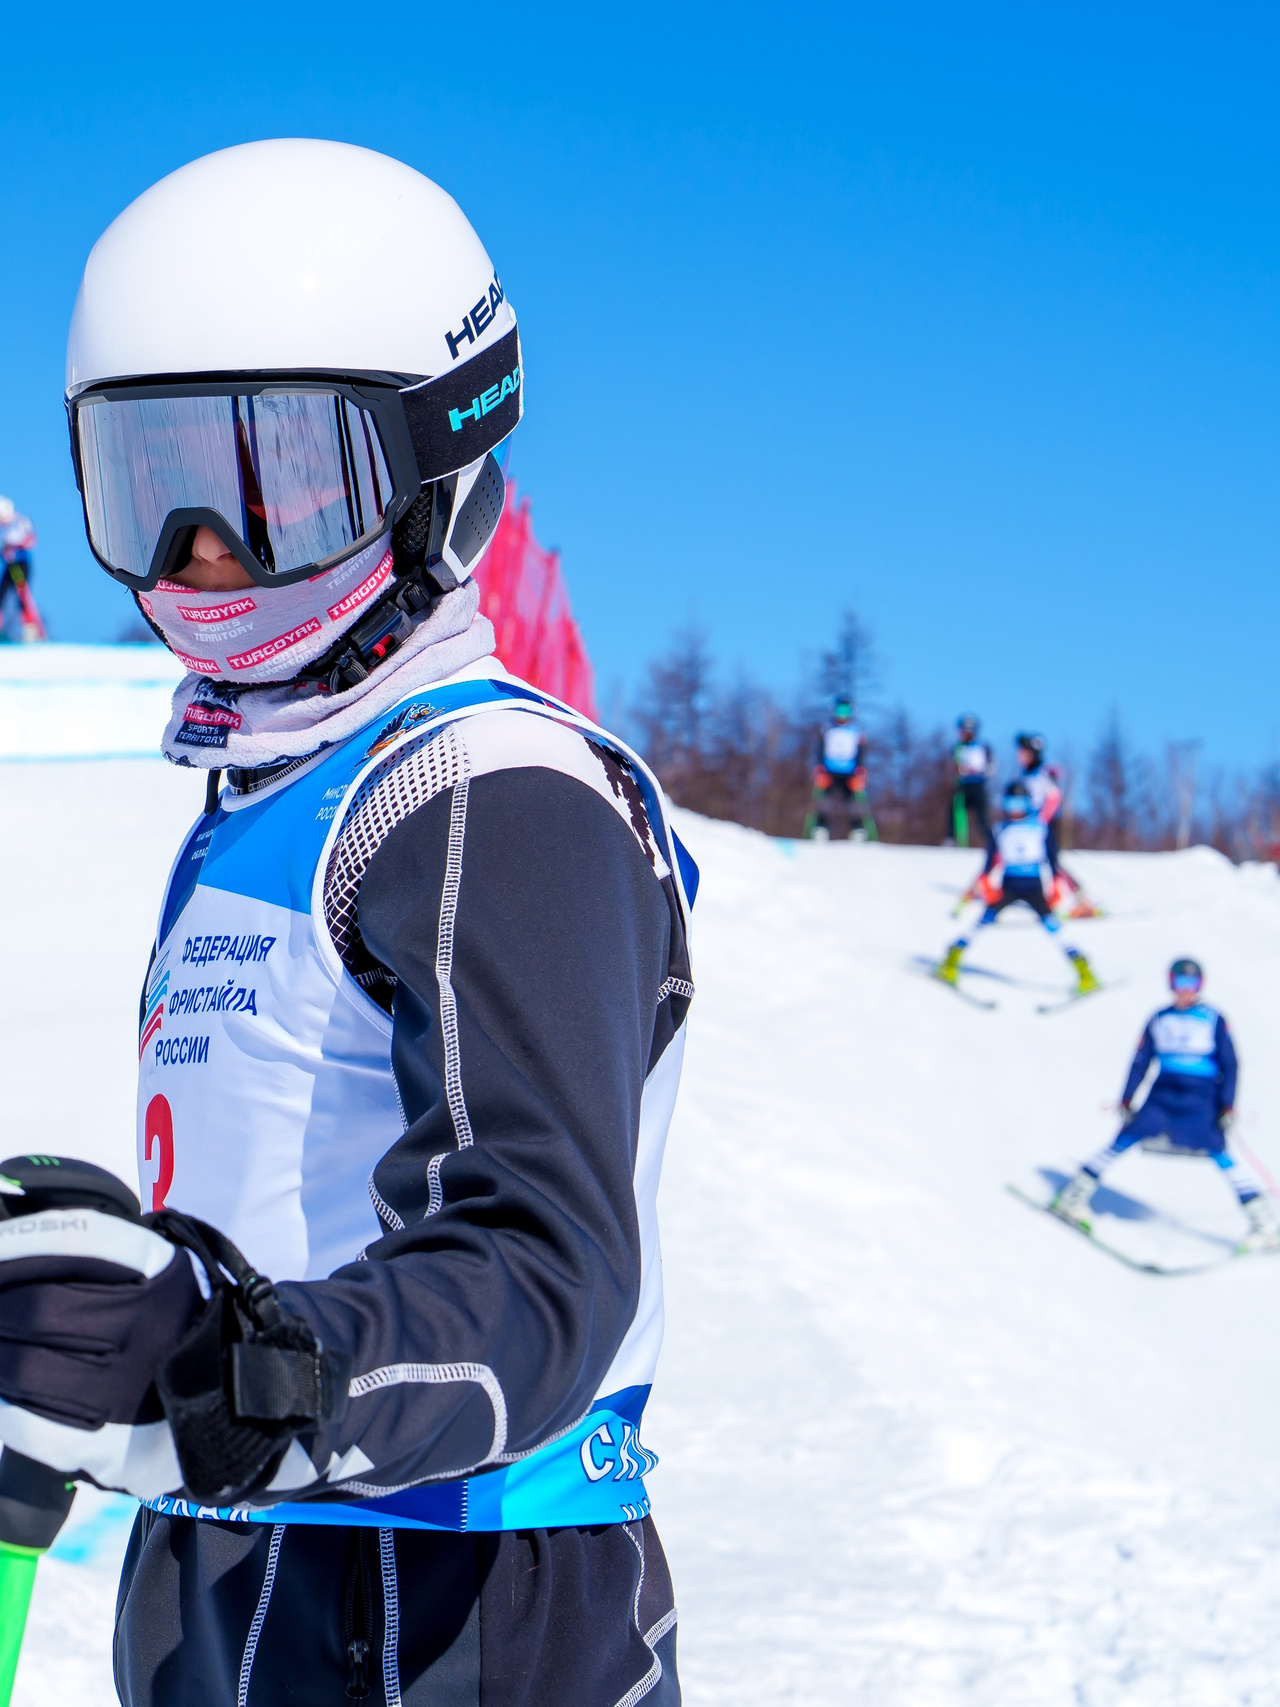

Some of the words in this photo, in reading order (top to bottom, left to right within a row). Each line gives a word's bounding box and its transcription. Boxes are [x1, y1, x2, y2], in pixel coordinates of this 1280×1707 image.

[330, 554, 393, 616] TURGOYAK
[179, 599, 254, 620] TURGOYAK
[193, 622, 255, 642] TERRITORY
[198, 618, 241, 632] SPORTS
[229, 620, 320, 669] TURGOYAK
[178, 655, 219, 672] GOYAK
[179, 731, 226, 744] TERRITORY
[188, 724, 219, 735] SPORTS
[182, 934, 277, 968] ФЕДЕРАЦИЯ
[168, 979, 258, 1017] ФРИСТАЙЛА
[155, 1036, 210, 1067] РОССИИ
